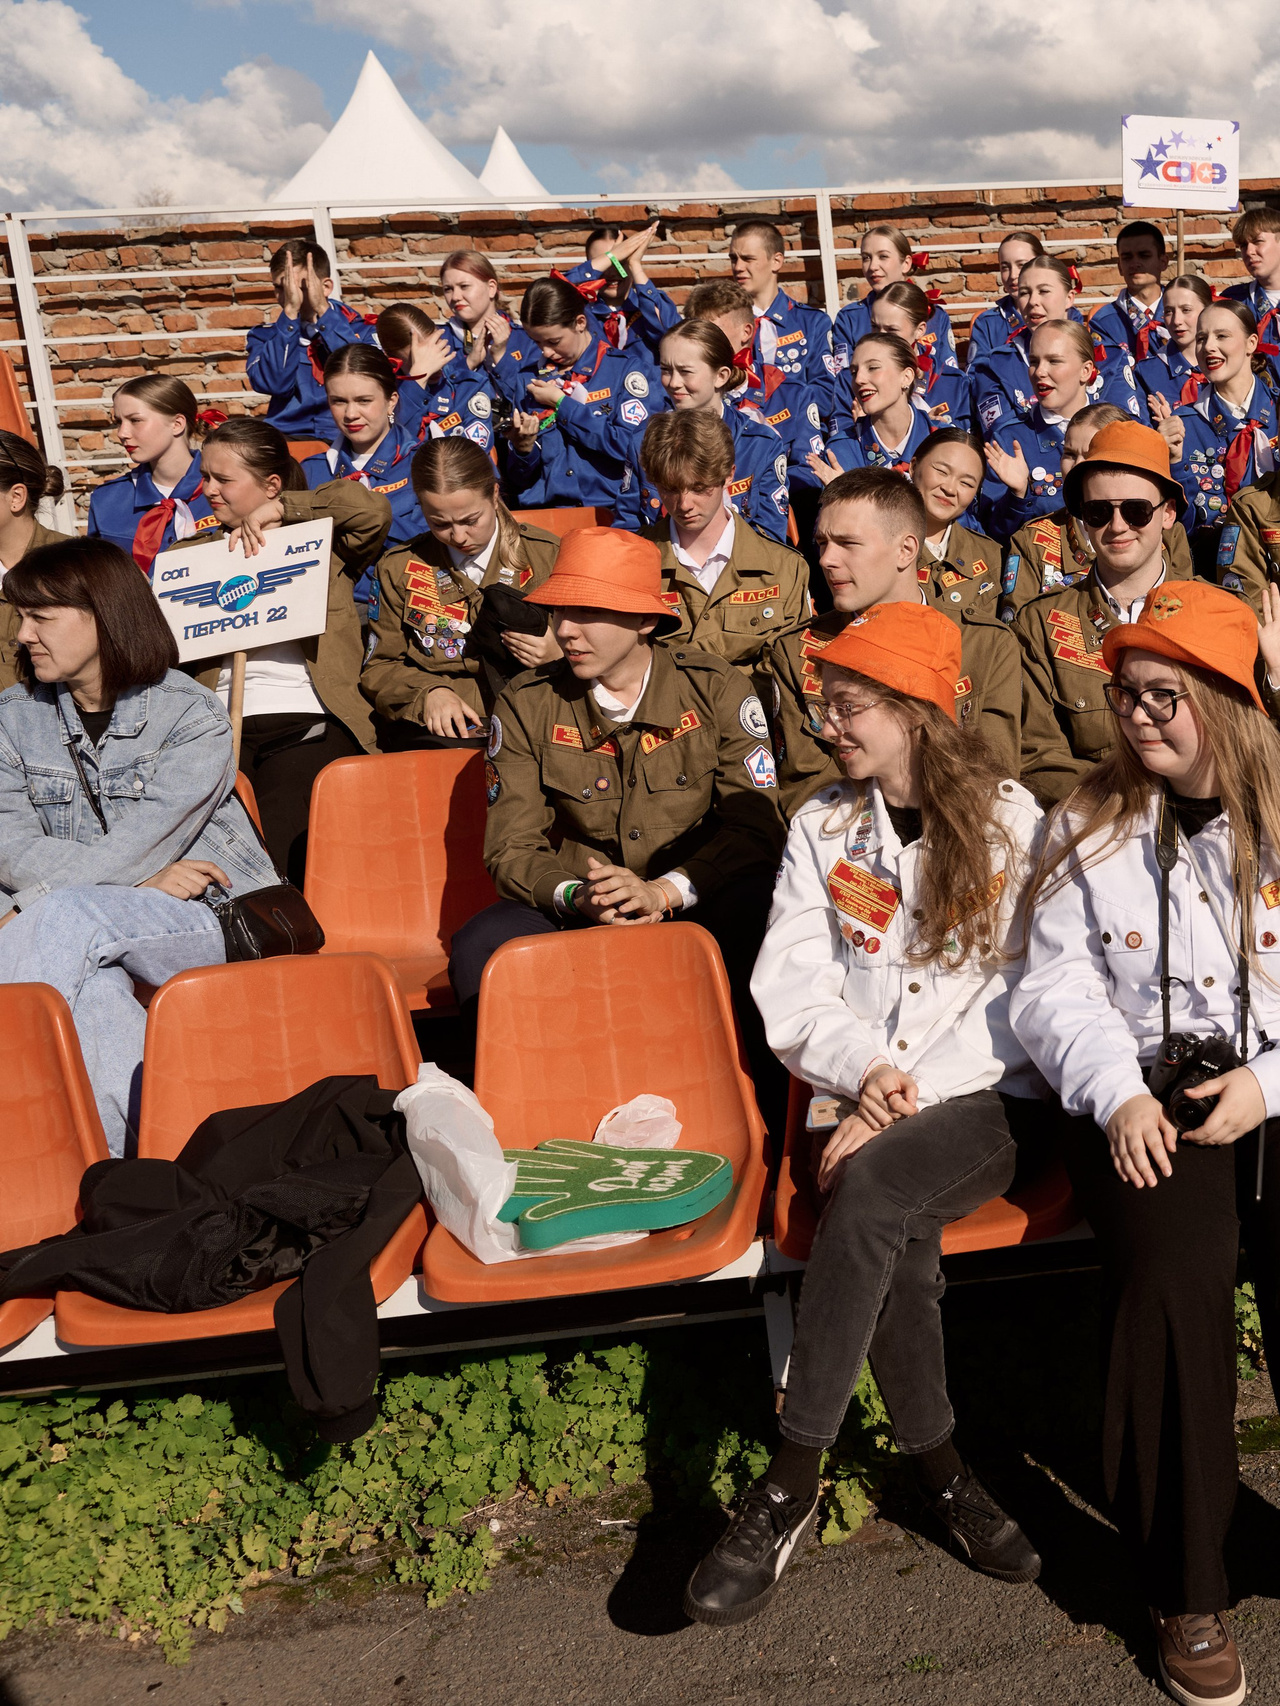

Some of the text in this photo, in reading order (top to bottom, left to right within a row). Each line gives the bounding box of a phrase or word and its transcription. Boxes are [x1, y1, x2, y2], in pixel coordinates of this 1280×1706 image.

[285, 539, 323, 556] АлтГУ
[161, 567, 189, 582] СОП
[183, 605, 288, 640] ПЕРРОН 22
[1201, 1060, 1219, 1070] Nikon
